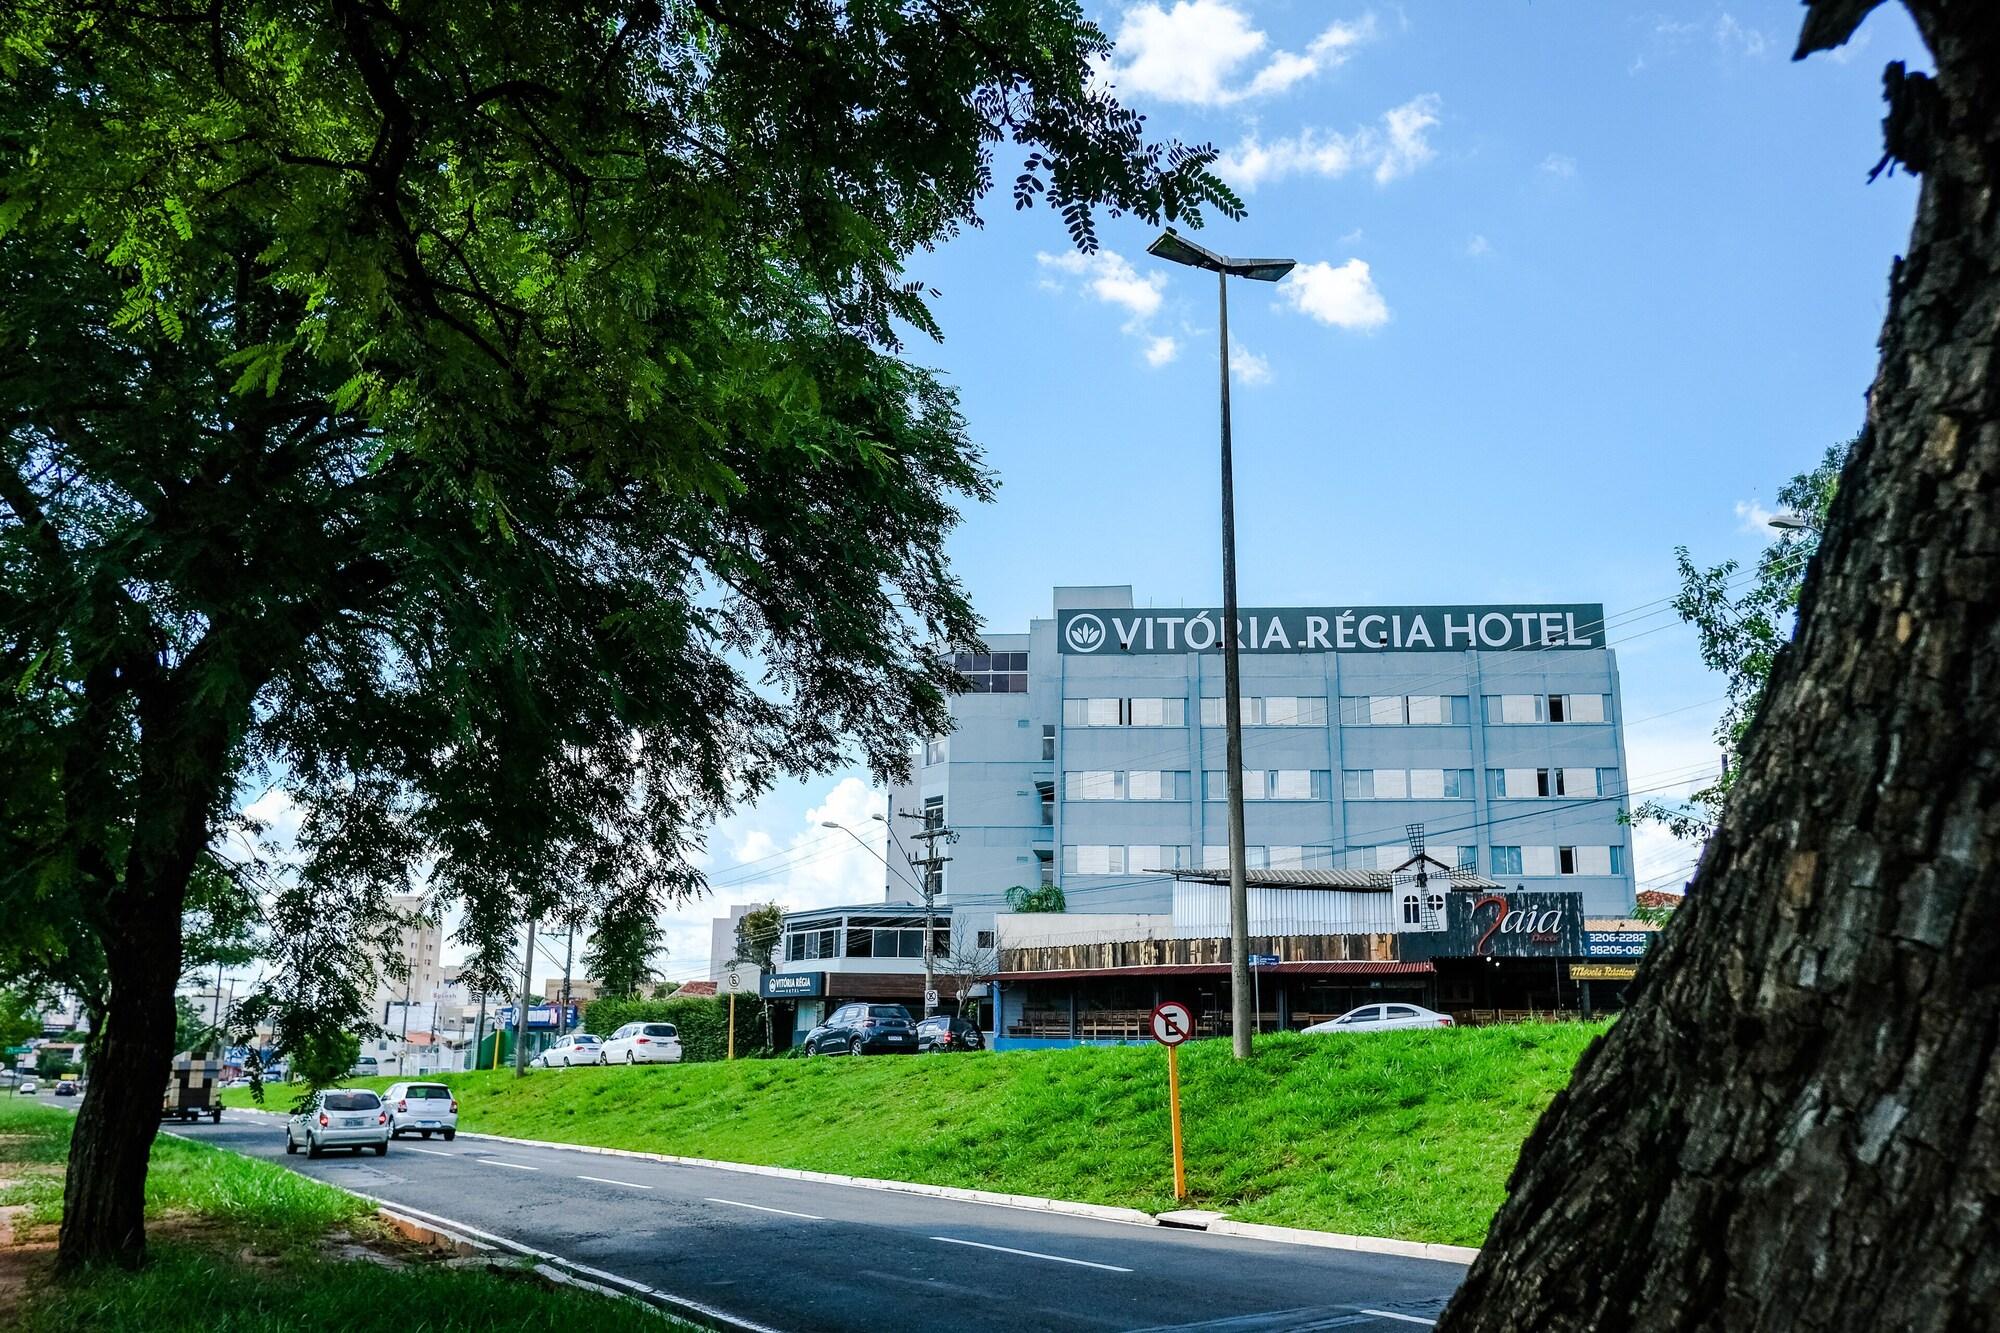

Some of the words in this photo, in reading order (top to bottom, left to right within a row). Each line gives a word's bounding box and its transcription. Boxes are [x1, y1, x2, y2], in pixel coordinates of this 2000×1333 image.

[1305, 609, 1435, 649] RÉGIA
[1443, 612, 1592, 648] HOTEL
[1589, 933, 1647, 942] 3206-2282
[775, 976, 796, 988] VITÓRIA
[795, 976, 811, 988] RÉGIA
[1164, 1012, 1179, 1037] E
